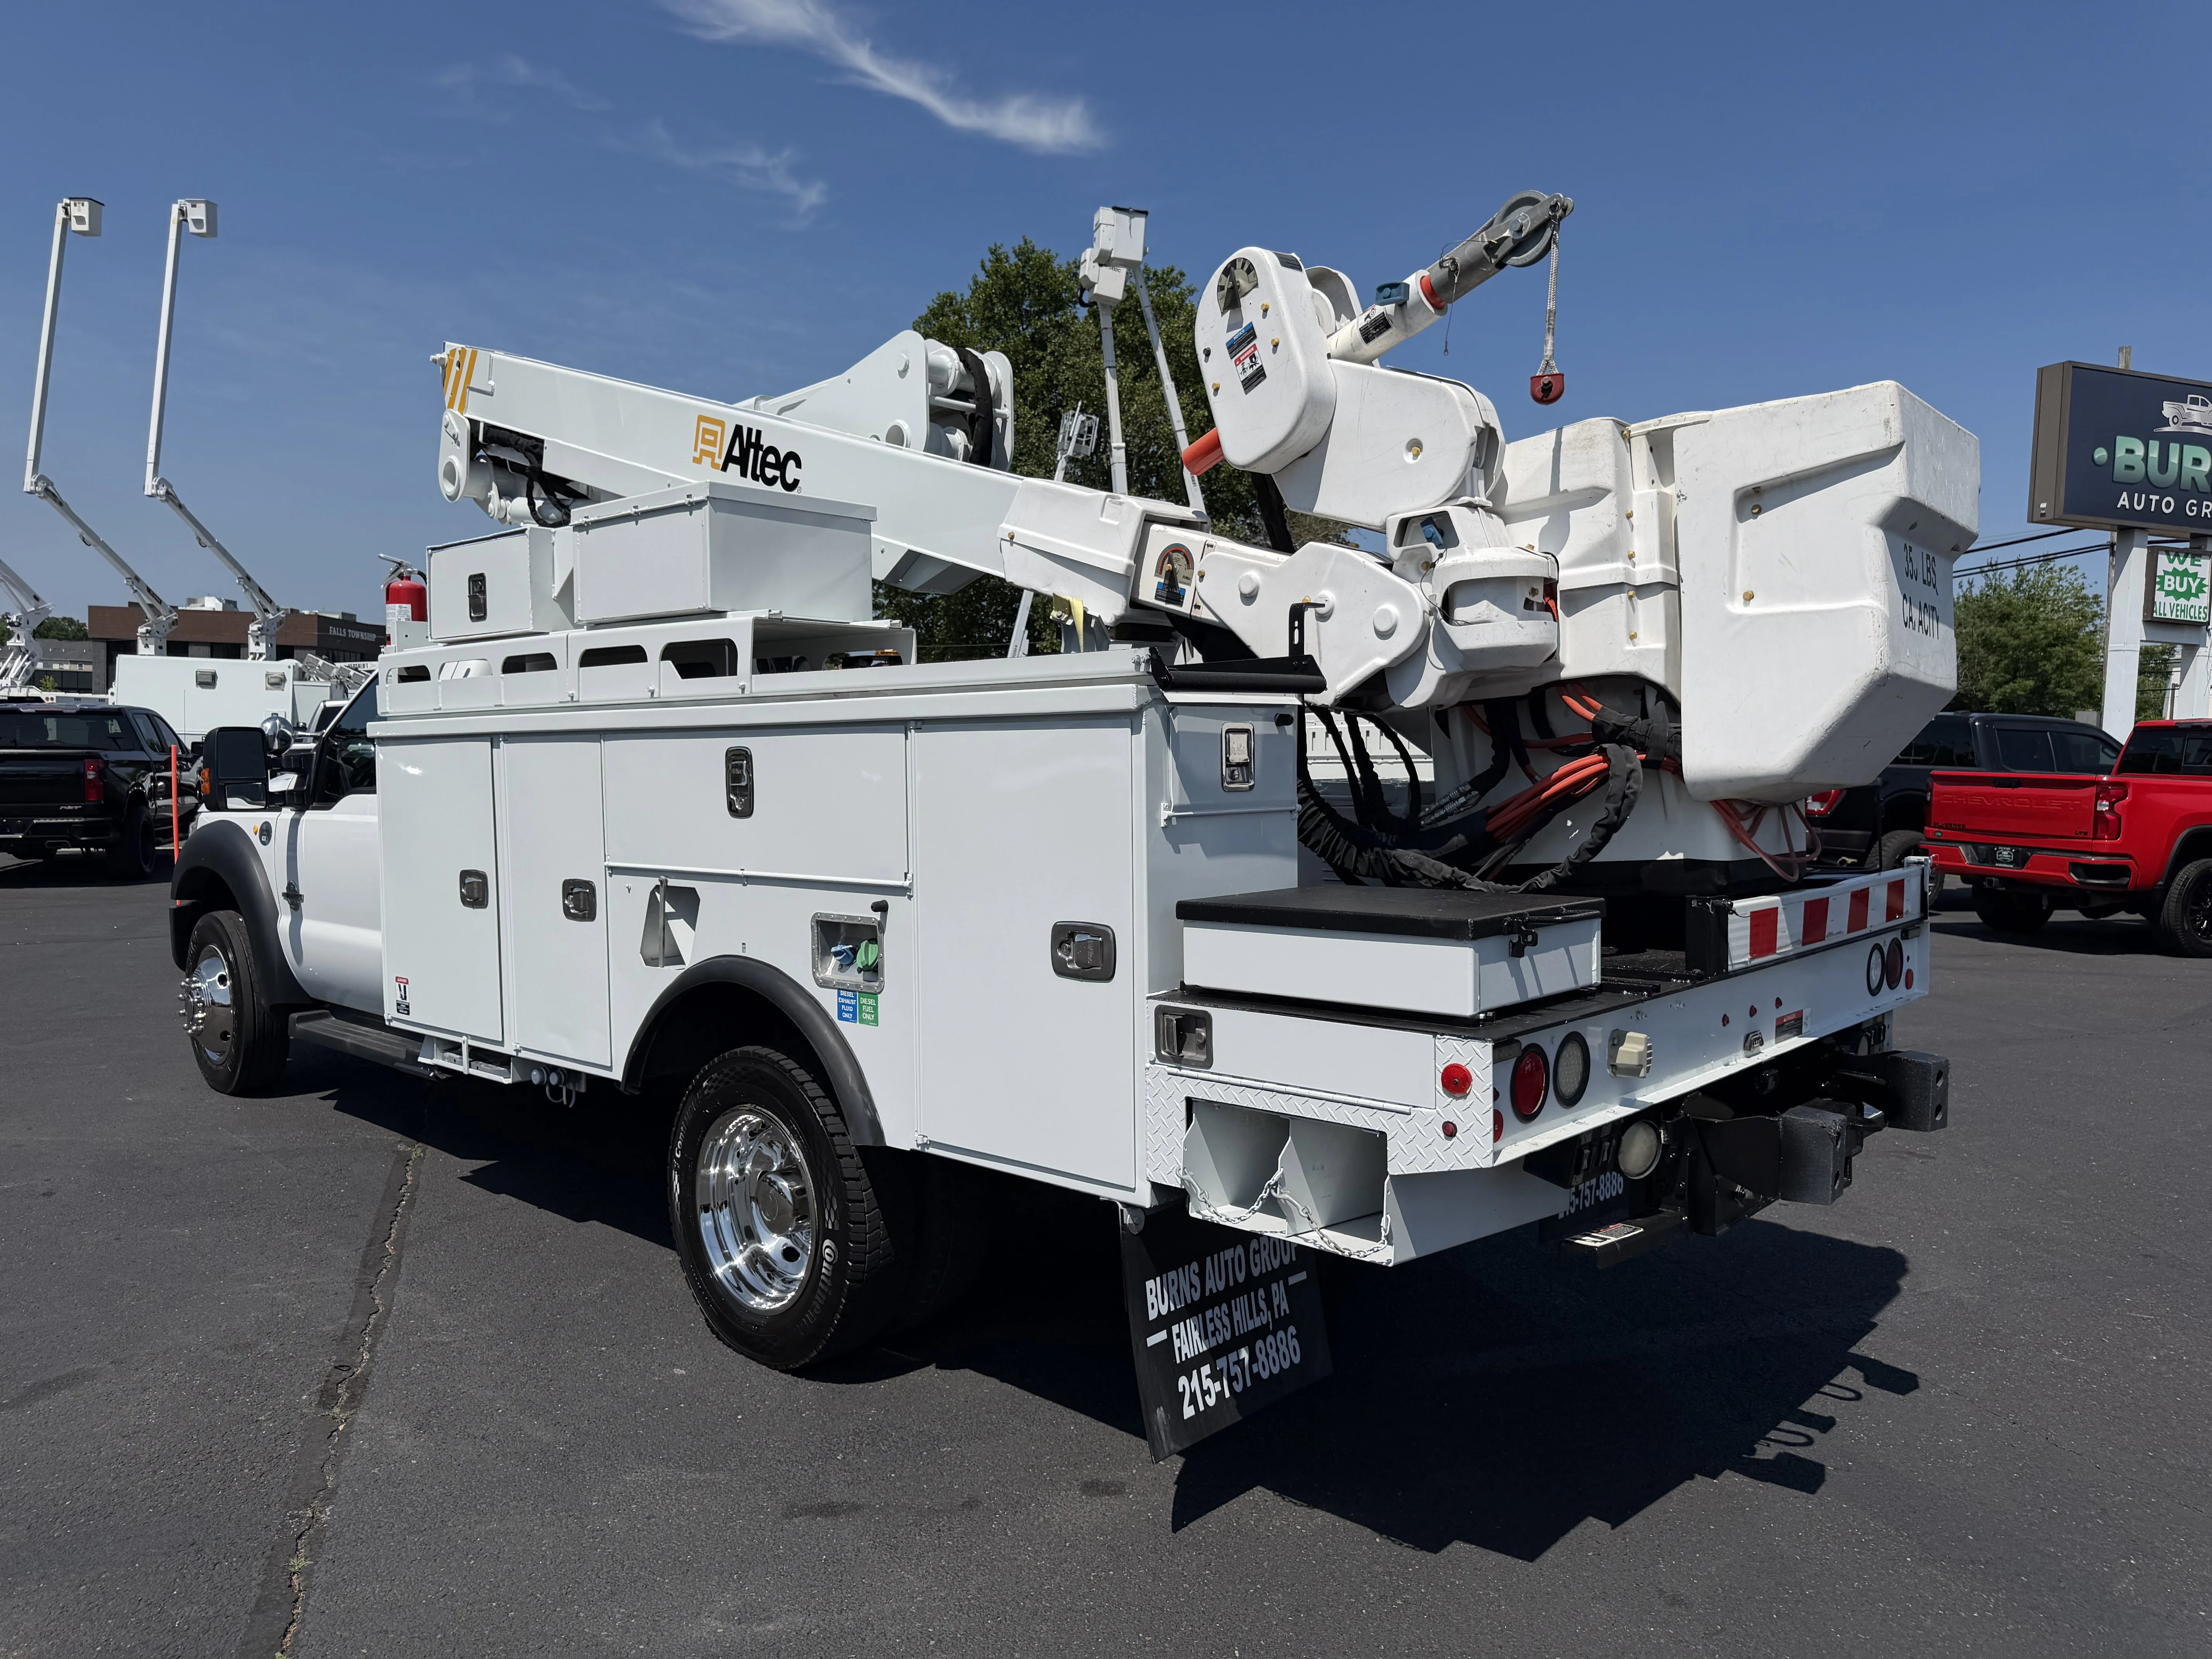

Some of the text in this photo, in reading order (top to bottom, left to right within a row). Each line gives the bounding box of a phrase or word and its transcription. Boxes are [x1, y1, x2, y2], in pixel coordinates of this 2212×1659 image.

[720, 424, 802, 492] Altec
[2117, 491, 2174, 514] AUTO
[2165, 551, 2202, 567] WE
[2164, 575, 2200, 593] BUY
[1902, 593, 1939, 640] CAACITY
[2154, 601, 2207, 621] ALL VEHICLES
[330, 626, 376, 641] FALLS TOWNSHIP
[1940, 794, 2081, 811] CHEVROLET
[860, 998, 876, 1006] DIESEL
[1558, 1171, 1623, 1219] 5-757-8886
[1146, 1261, 1200, 1321] BURNS
[1205, 1245, 1245, 1297] AUTO
[1172, 1279, 1290, 1364] FAIRLESS HILLS, PA
[1178, 1325, 1300, 1420] 215-757-8886
